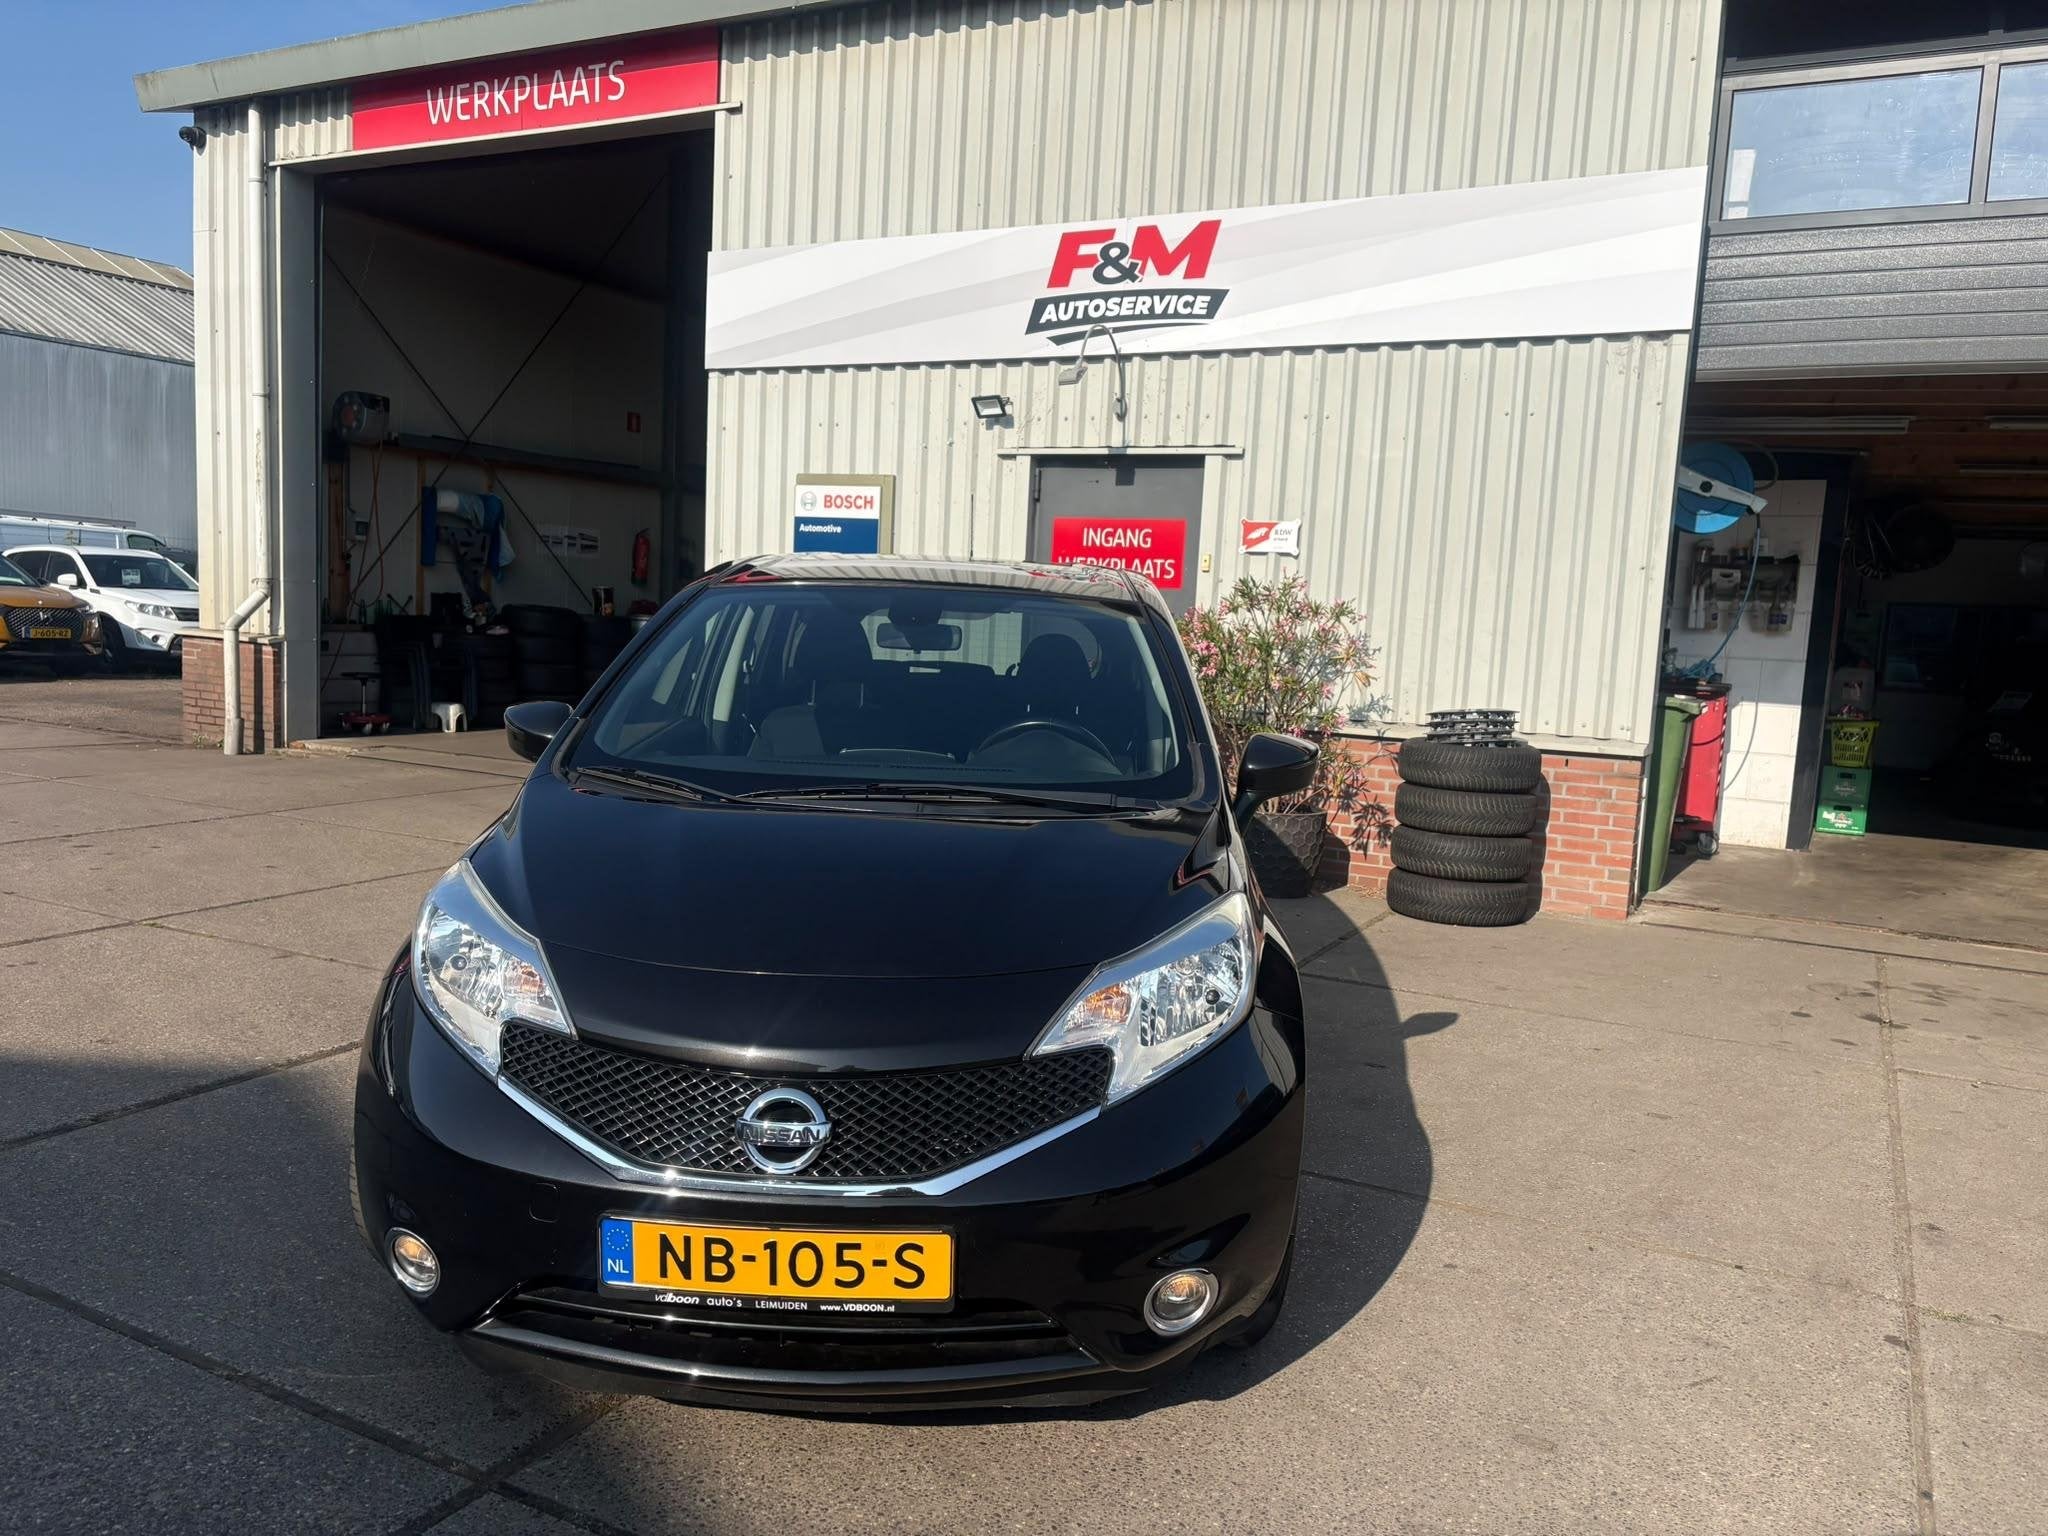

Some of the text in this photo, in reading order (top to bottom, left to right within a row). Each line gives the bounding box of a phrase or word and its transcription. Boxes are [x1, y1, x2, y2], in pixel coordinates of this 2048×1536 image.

[427, 60, 625, 125] WERKPLAATS
[1047, 219, 1222, 288] F&M
[1039, 295, 1211, 324] AUTOSERVICE
[823, 494, 874, 510] BOSCH
[799, 523, 842, 533] Automotive
[1082, 527, 1152, 548] INGANG
[743, 1125, 820, 1142] NISSAN
[607, 1258, 629, 1274] NL
[658, 1233, 926, 1289] NB-105-S
[706, 1297, 742, 1307] auto's
[755, 1300, 808, 1310] LEIMUIDEN
[820, 1303, 895, 1312] www.VDBOON.nl
